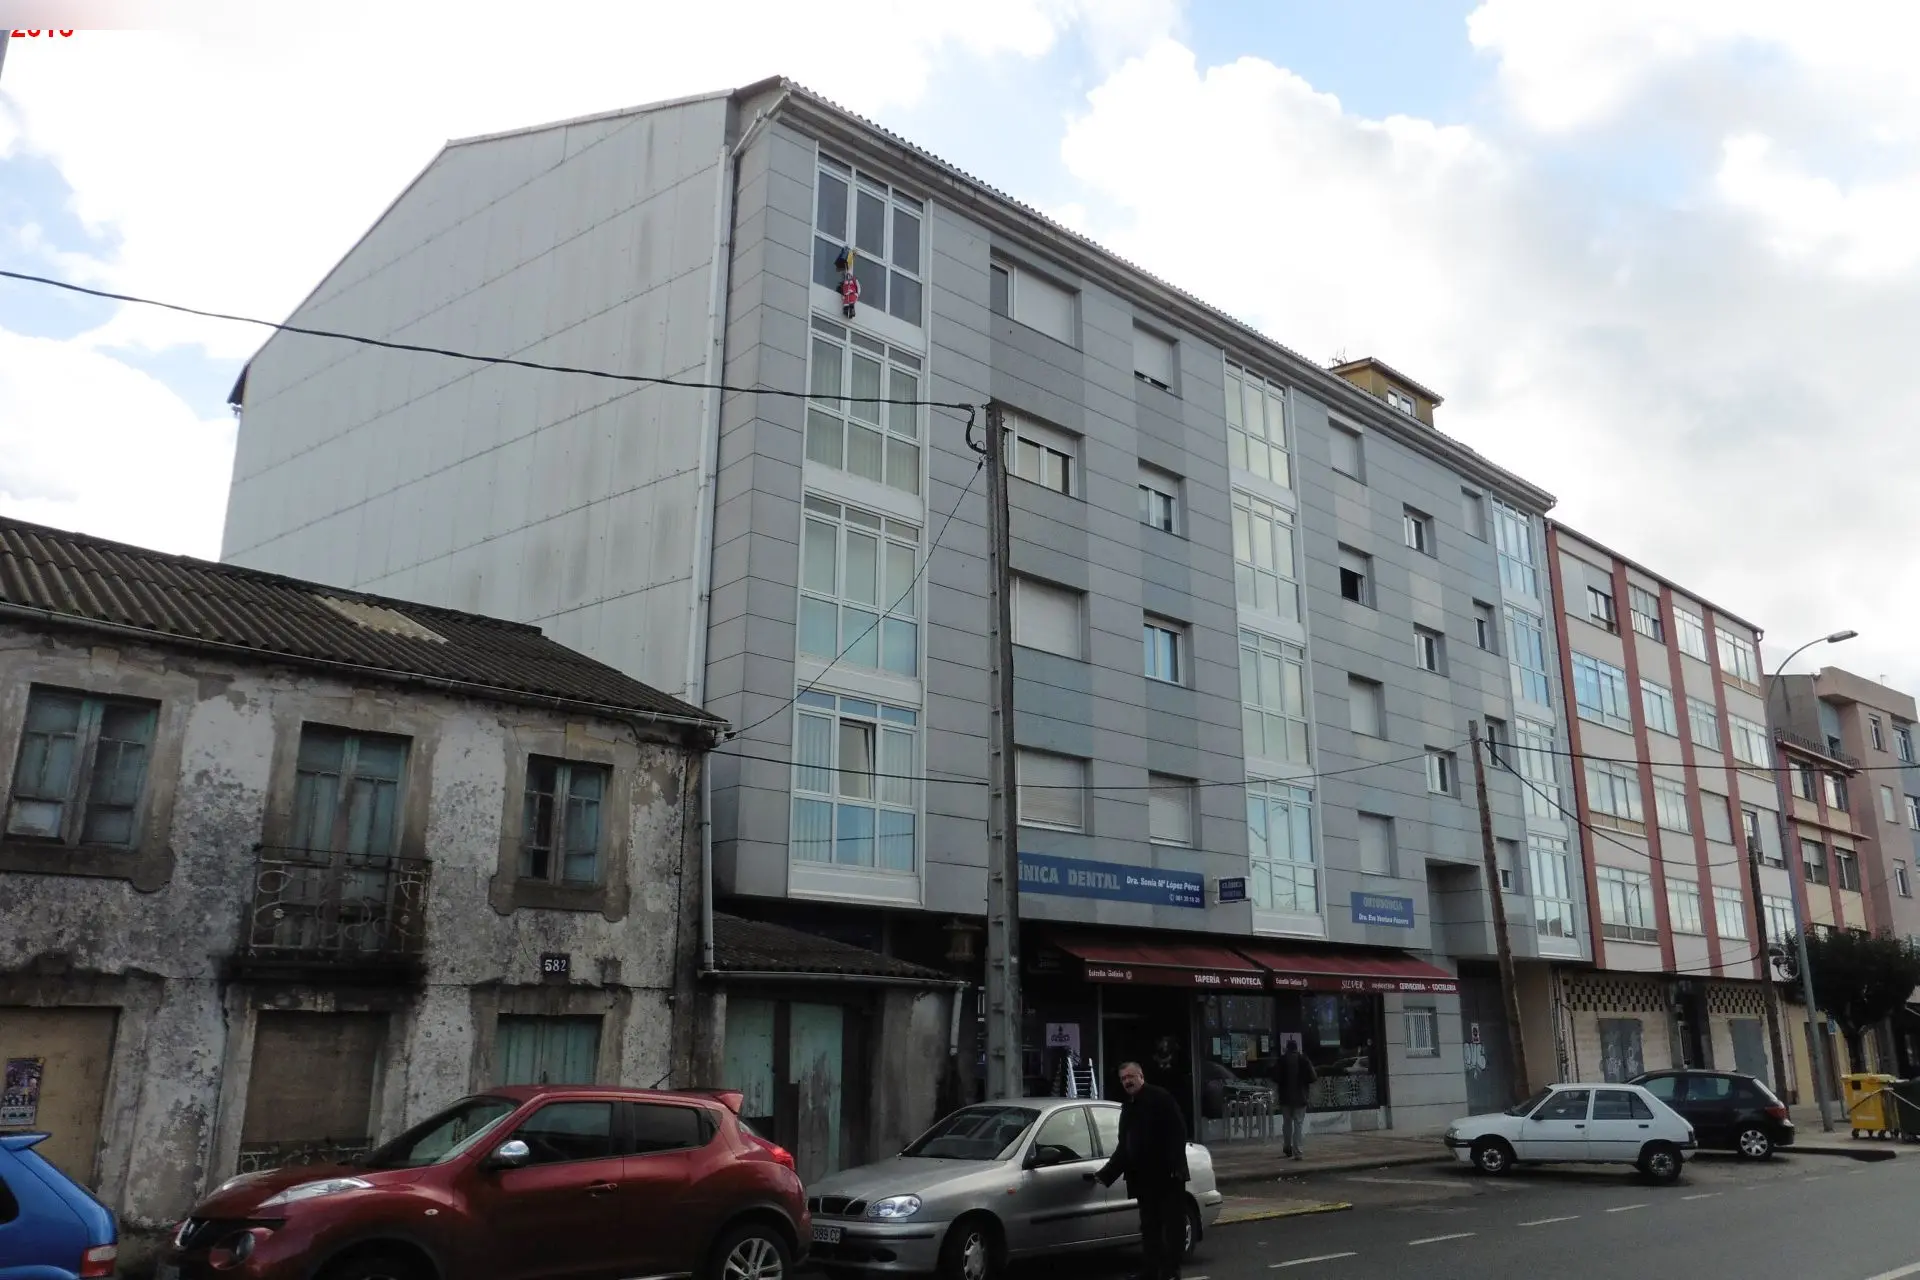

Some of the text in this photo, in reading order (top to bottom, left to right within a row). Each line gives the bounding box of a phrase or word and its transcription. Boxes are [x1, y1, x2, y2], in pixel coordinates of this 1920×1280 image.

[1067, 869, 1120, 890] DENTAL
[1126, 875, 1139, 885] Dra.
[1140, 877, 1157, 887] Sonia
[1166, 880, 1183, 891] López
[1183, 881, 1200, 892] Pérez
[544, 959, 567, 971] 582
[1194, 973, 1220, 984] TAPERÍA
[1230, 976, 1262, 986] VINOTECA
